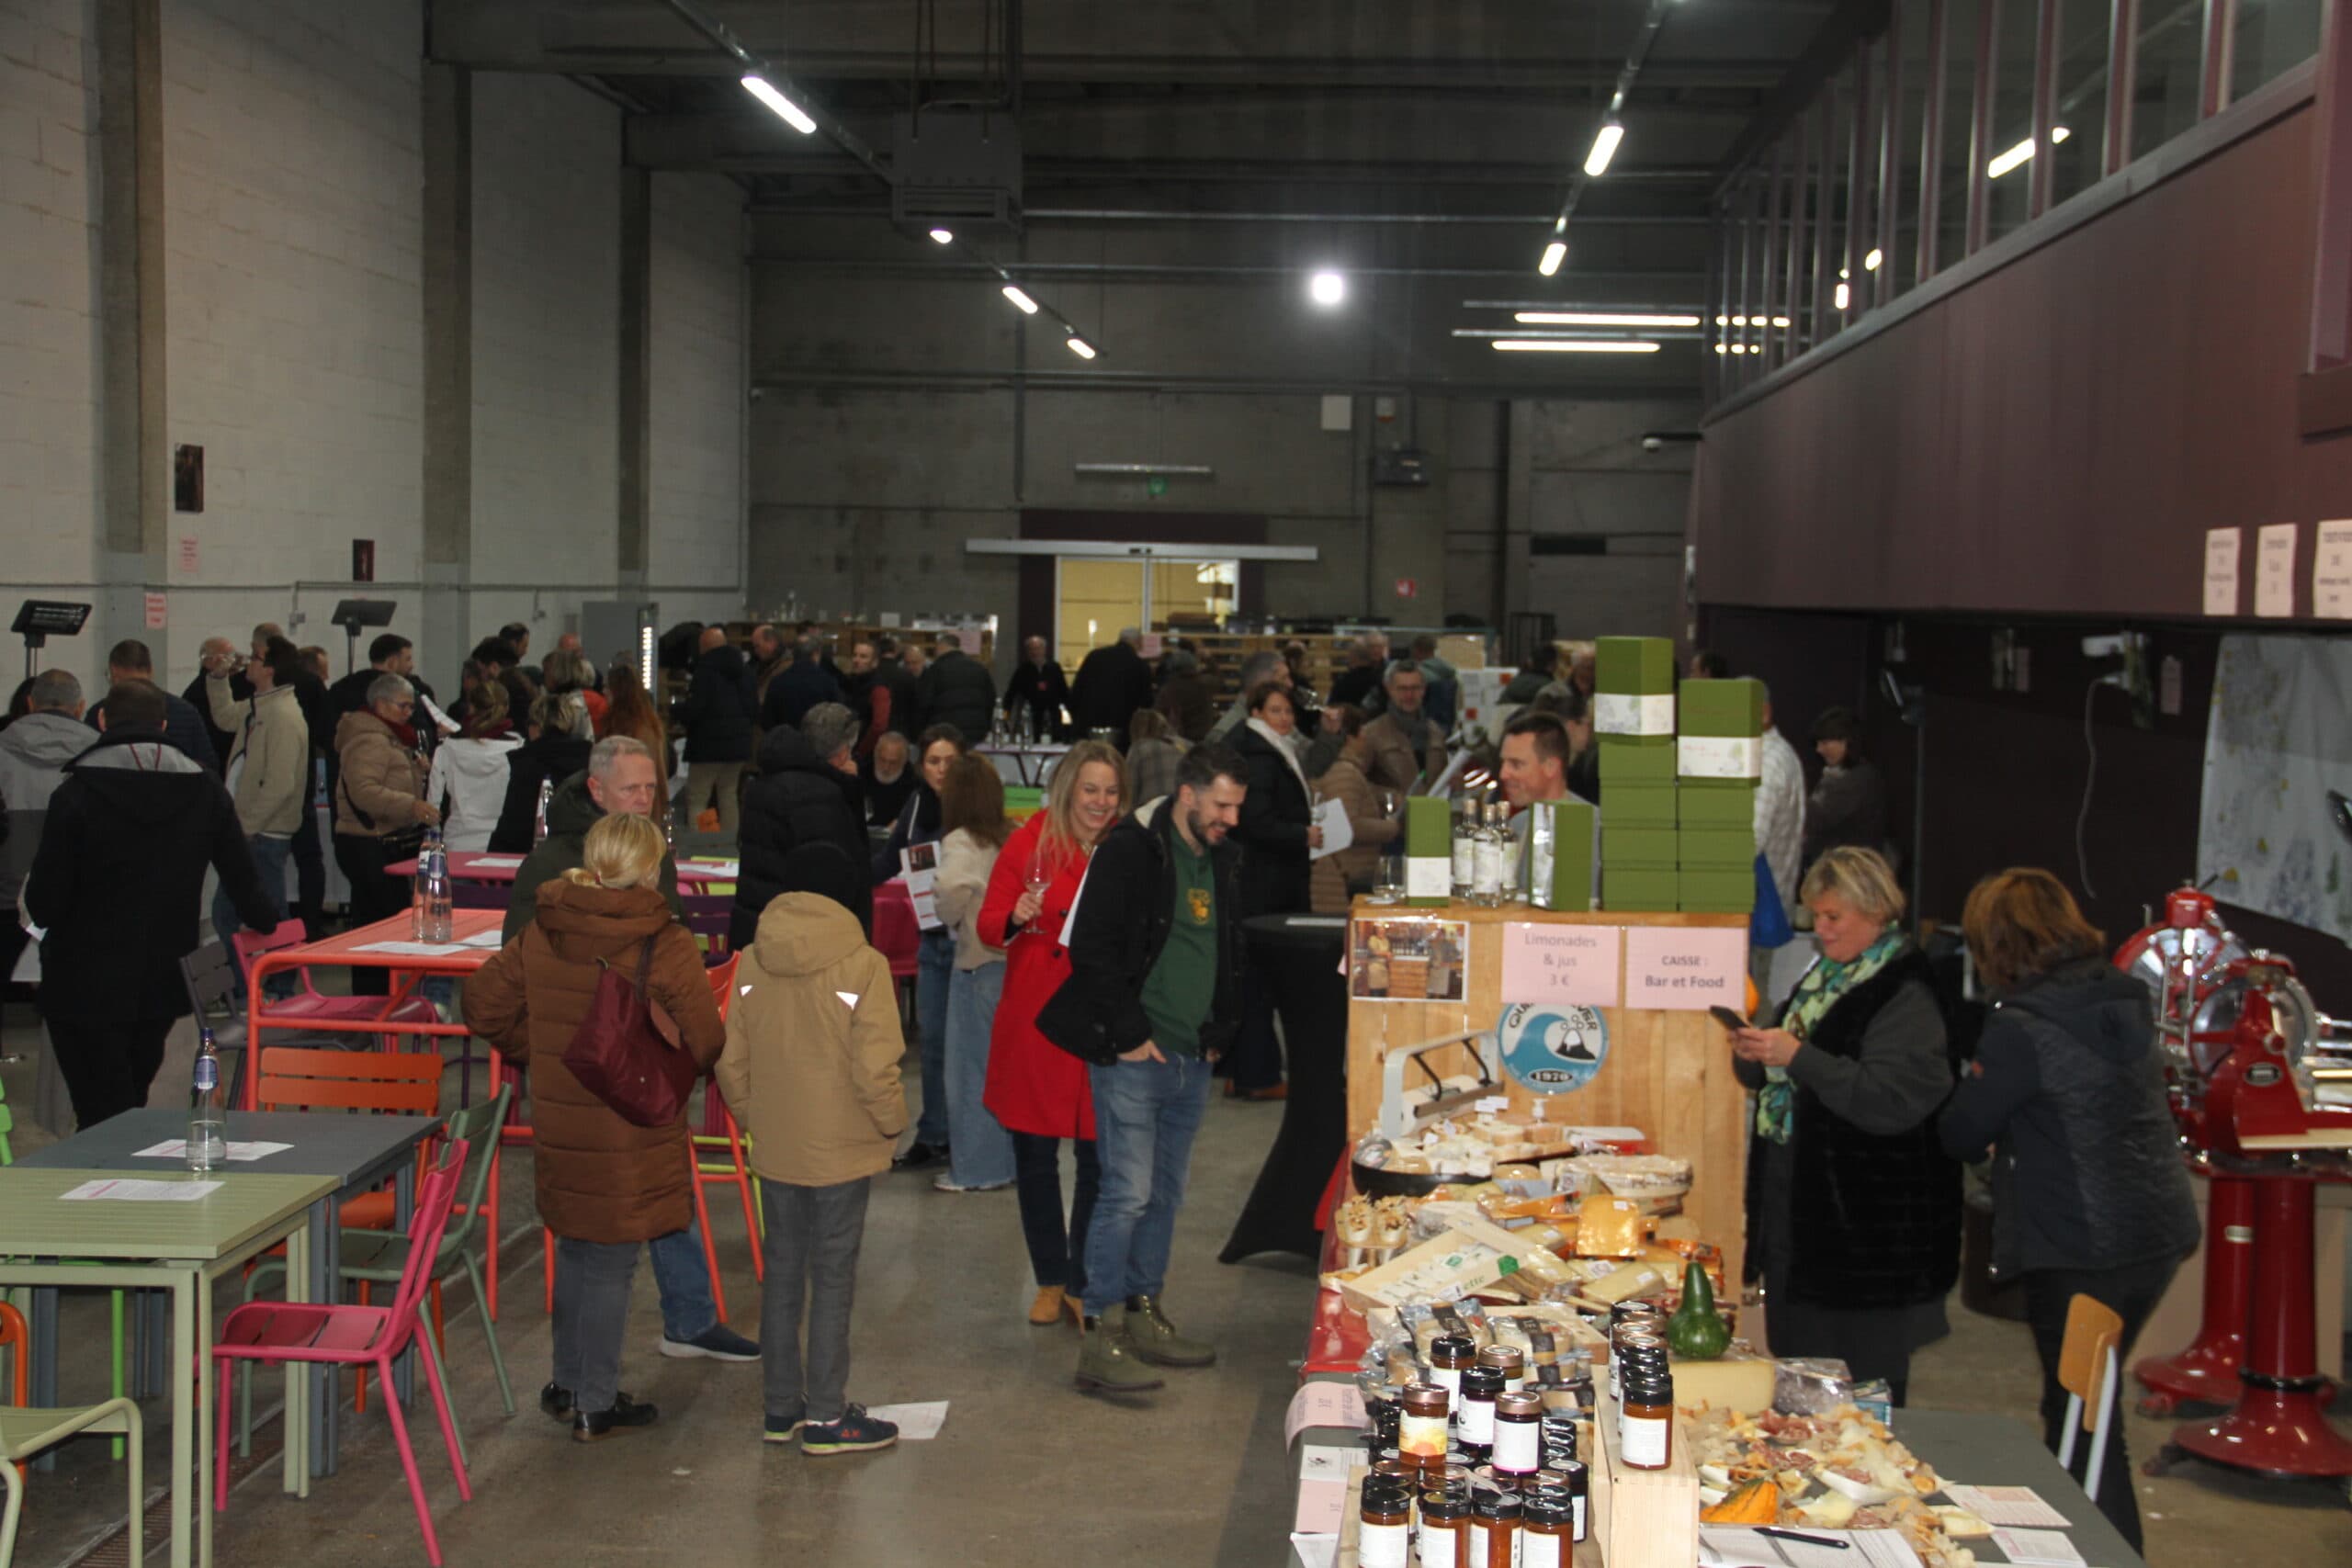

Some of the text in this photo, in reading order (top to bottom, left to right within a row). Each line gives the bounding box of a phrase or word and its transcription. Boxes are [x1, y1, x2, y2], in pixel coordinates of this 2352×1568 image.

[1524, 932, 1598, 947] Limonades
[1544, 953, 1577, 968] & jus
[1661, 954, 1700, 966] CAISSE
[1645, 975, 1724, 987] Bar et Food
